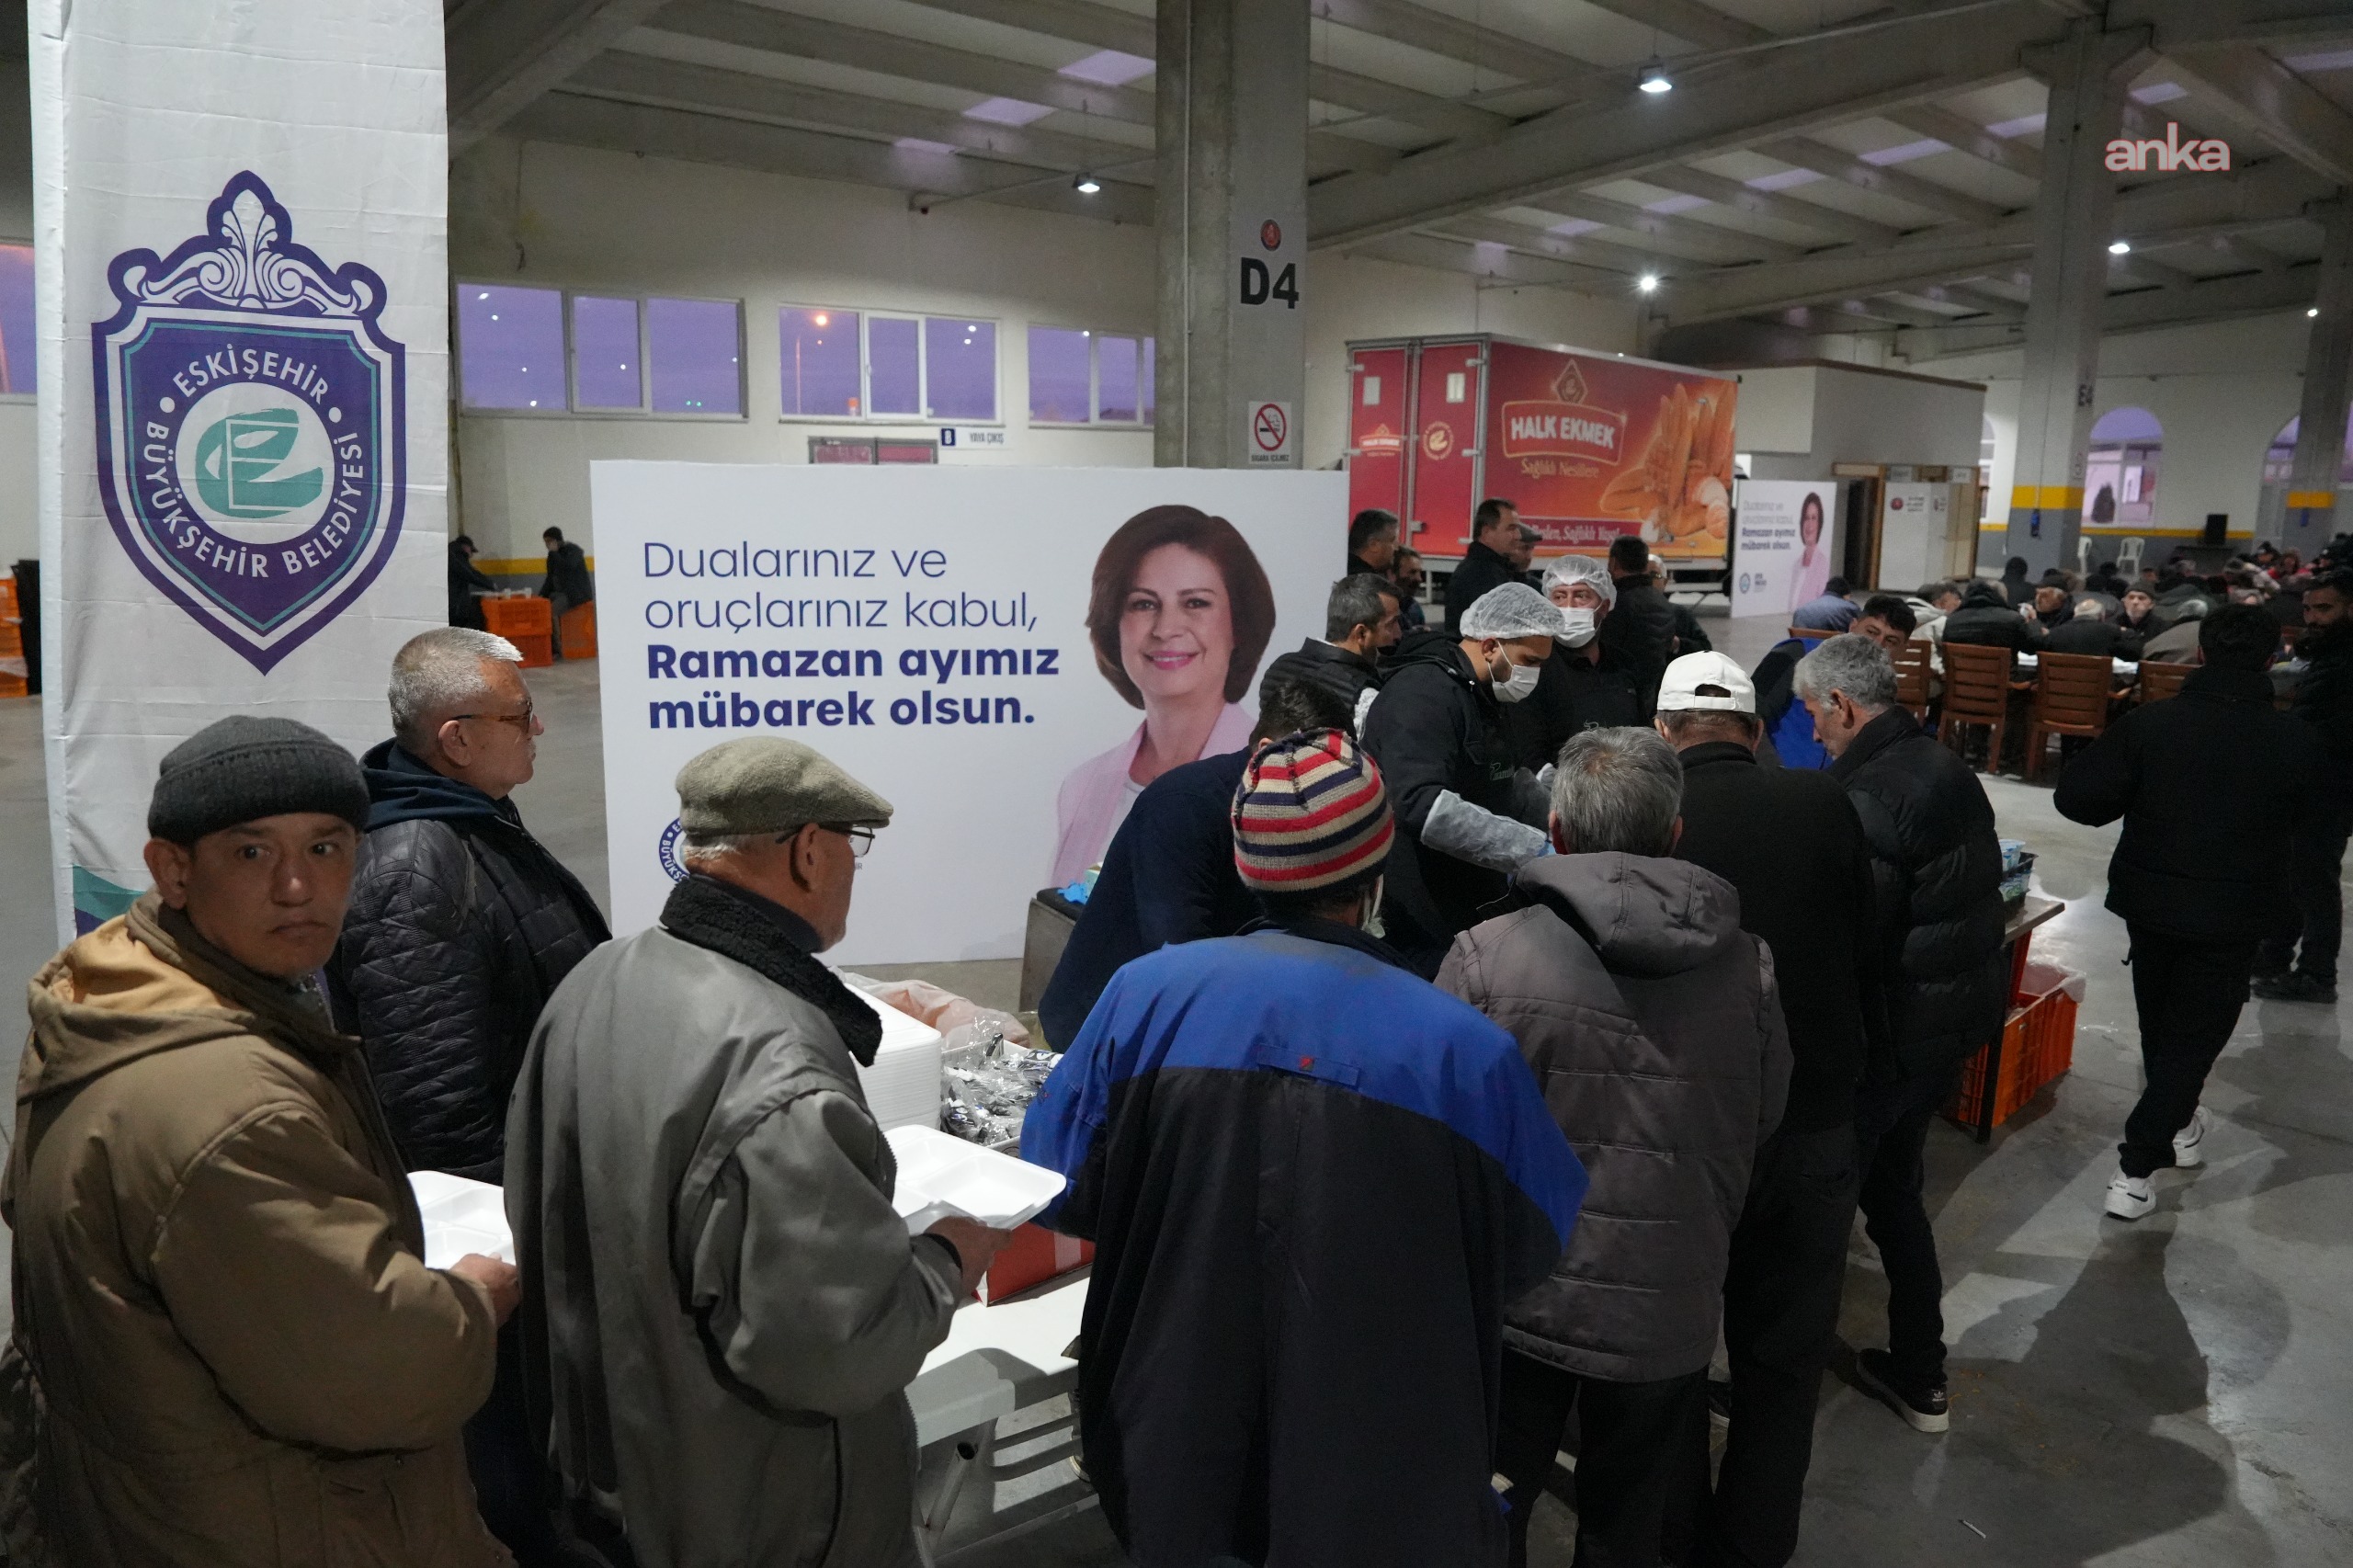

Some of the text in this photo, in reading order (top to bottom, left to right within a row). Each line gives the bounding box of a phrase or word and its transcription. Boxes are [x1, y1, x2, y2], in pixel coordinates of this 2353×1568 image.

[1241, 256, 1299, 309] D4
[173, 344, 328, 404] ESKİŞEHİR
[1511, 415, 1615, 449] HALK EKMEK
[144, 421, 364, 578] BÜYÜKŞEHİR BELEDİYESİ
[644, 540, 947, 578] Dualarınız ve
[645, 591, 1038, 634] oruçlarınız kabul,
[647, 644, 1060, 684] Ramazan ayımız
[649, 689, 1035, 729] mübarek olsun.
